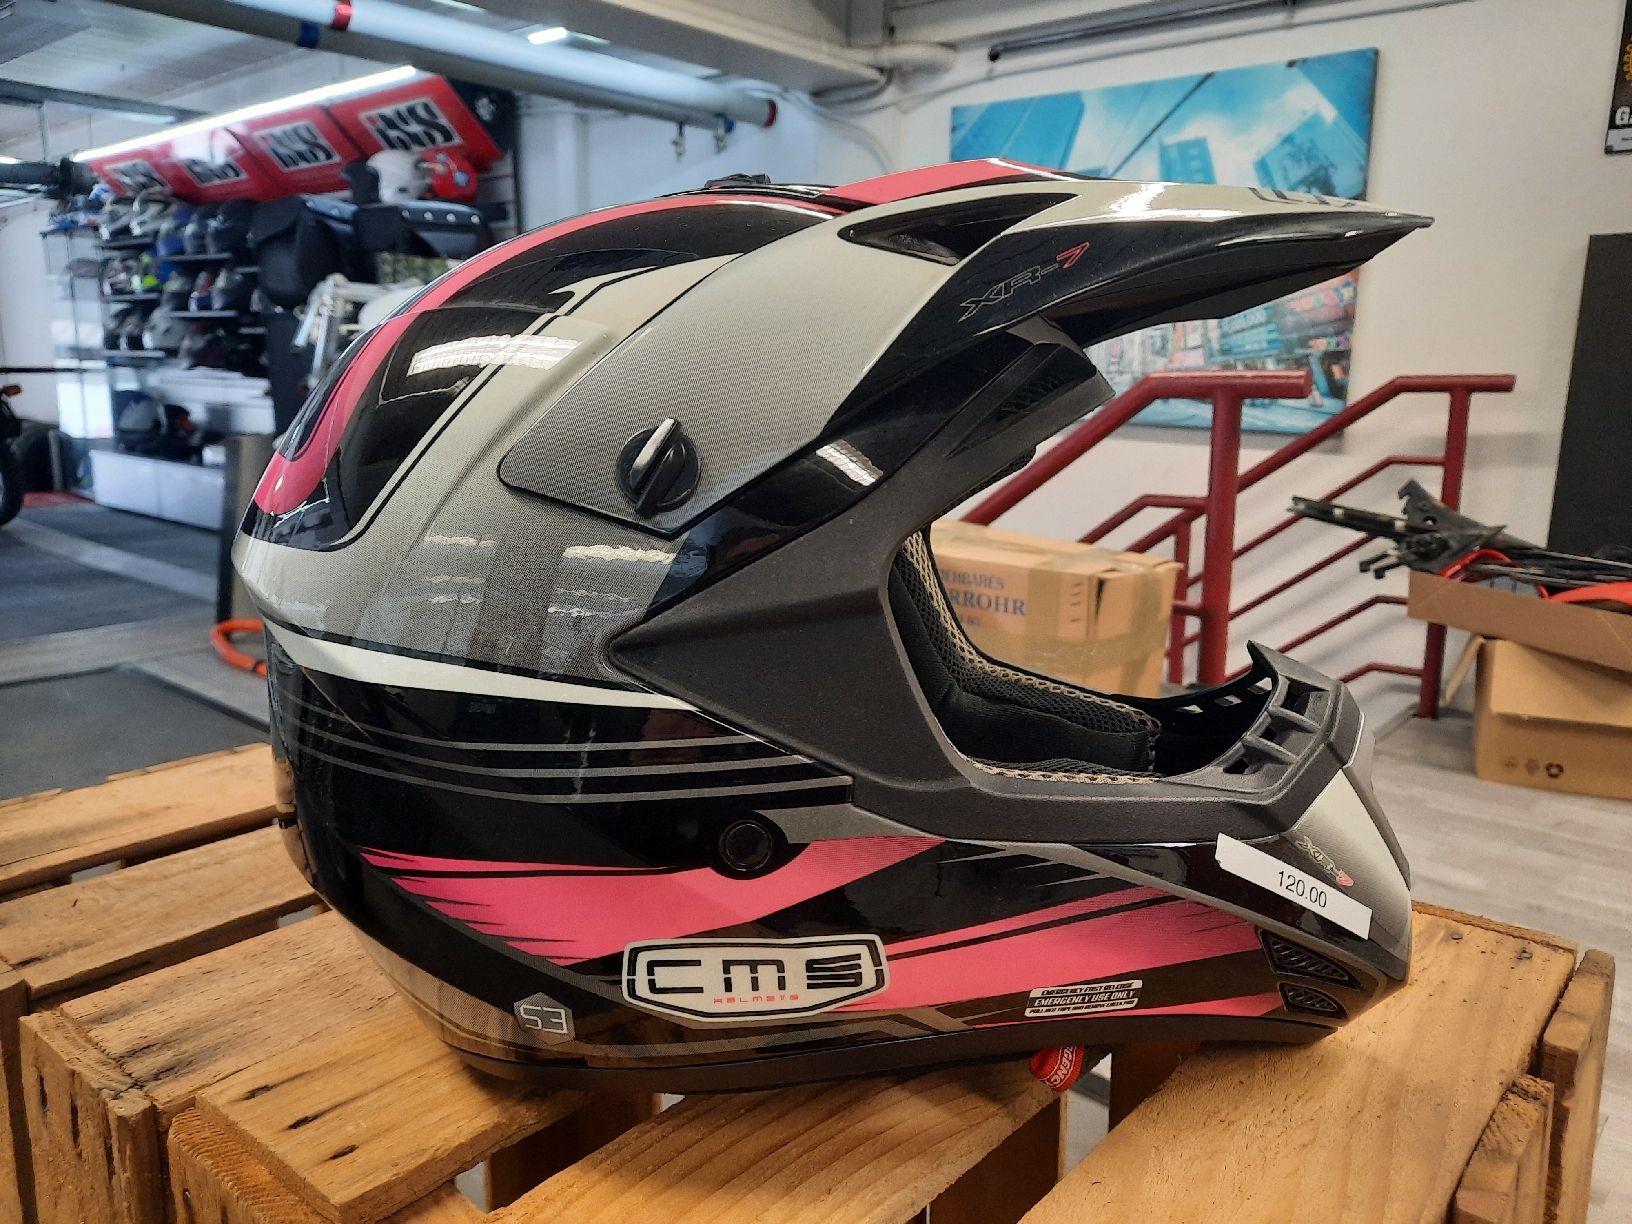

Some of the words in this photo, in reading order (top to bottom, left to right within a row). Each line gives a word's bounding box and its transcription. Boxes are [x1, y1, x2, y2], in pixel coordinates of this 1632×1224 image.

[958, 241, 1091, 323] XR-7
[1278, 870, 1327, 908] 120.00
[1033, 994, 1092, 1007] EMERGENCY
[1091, 992, 1111, 1002] USE
[1110, 990, 1135, 1000] ONLY
[520, 1004, 568, 1035] S3
